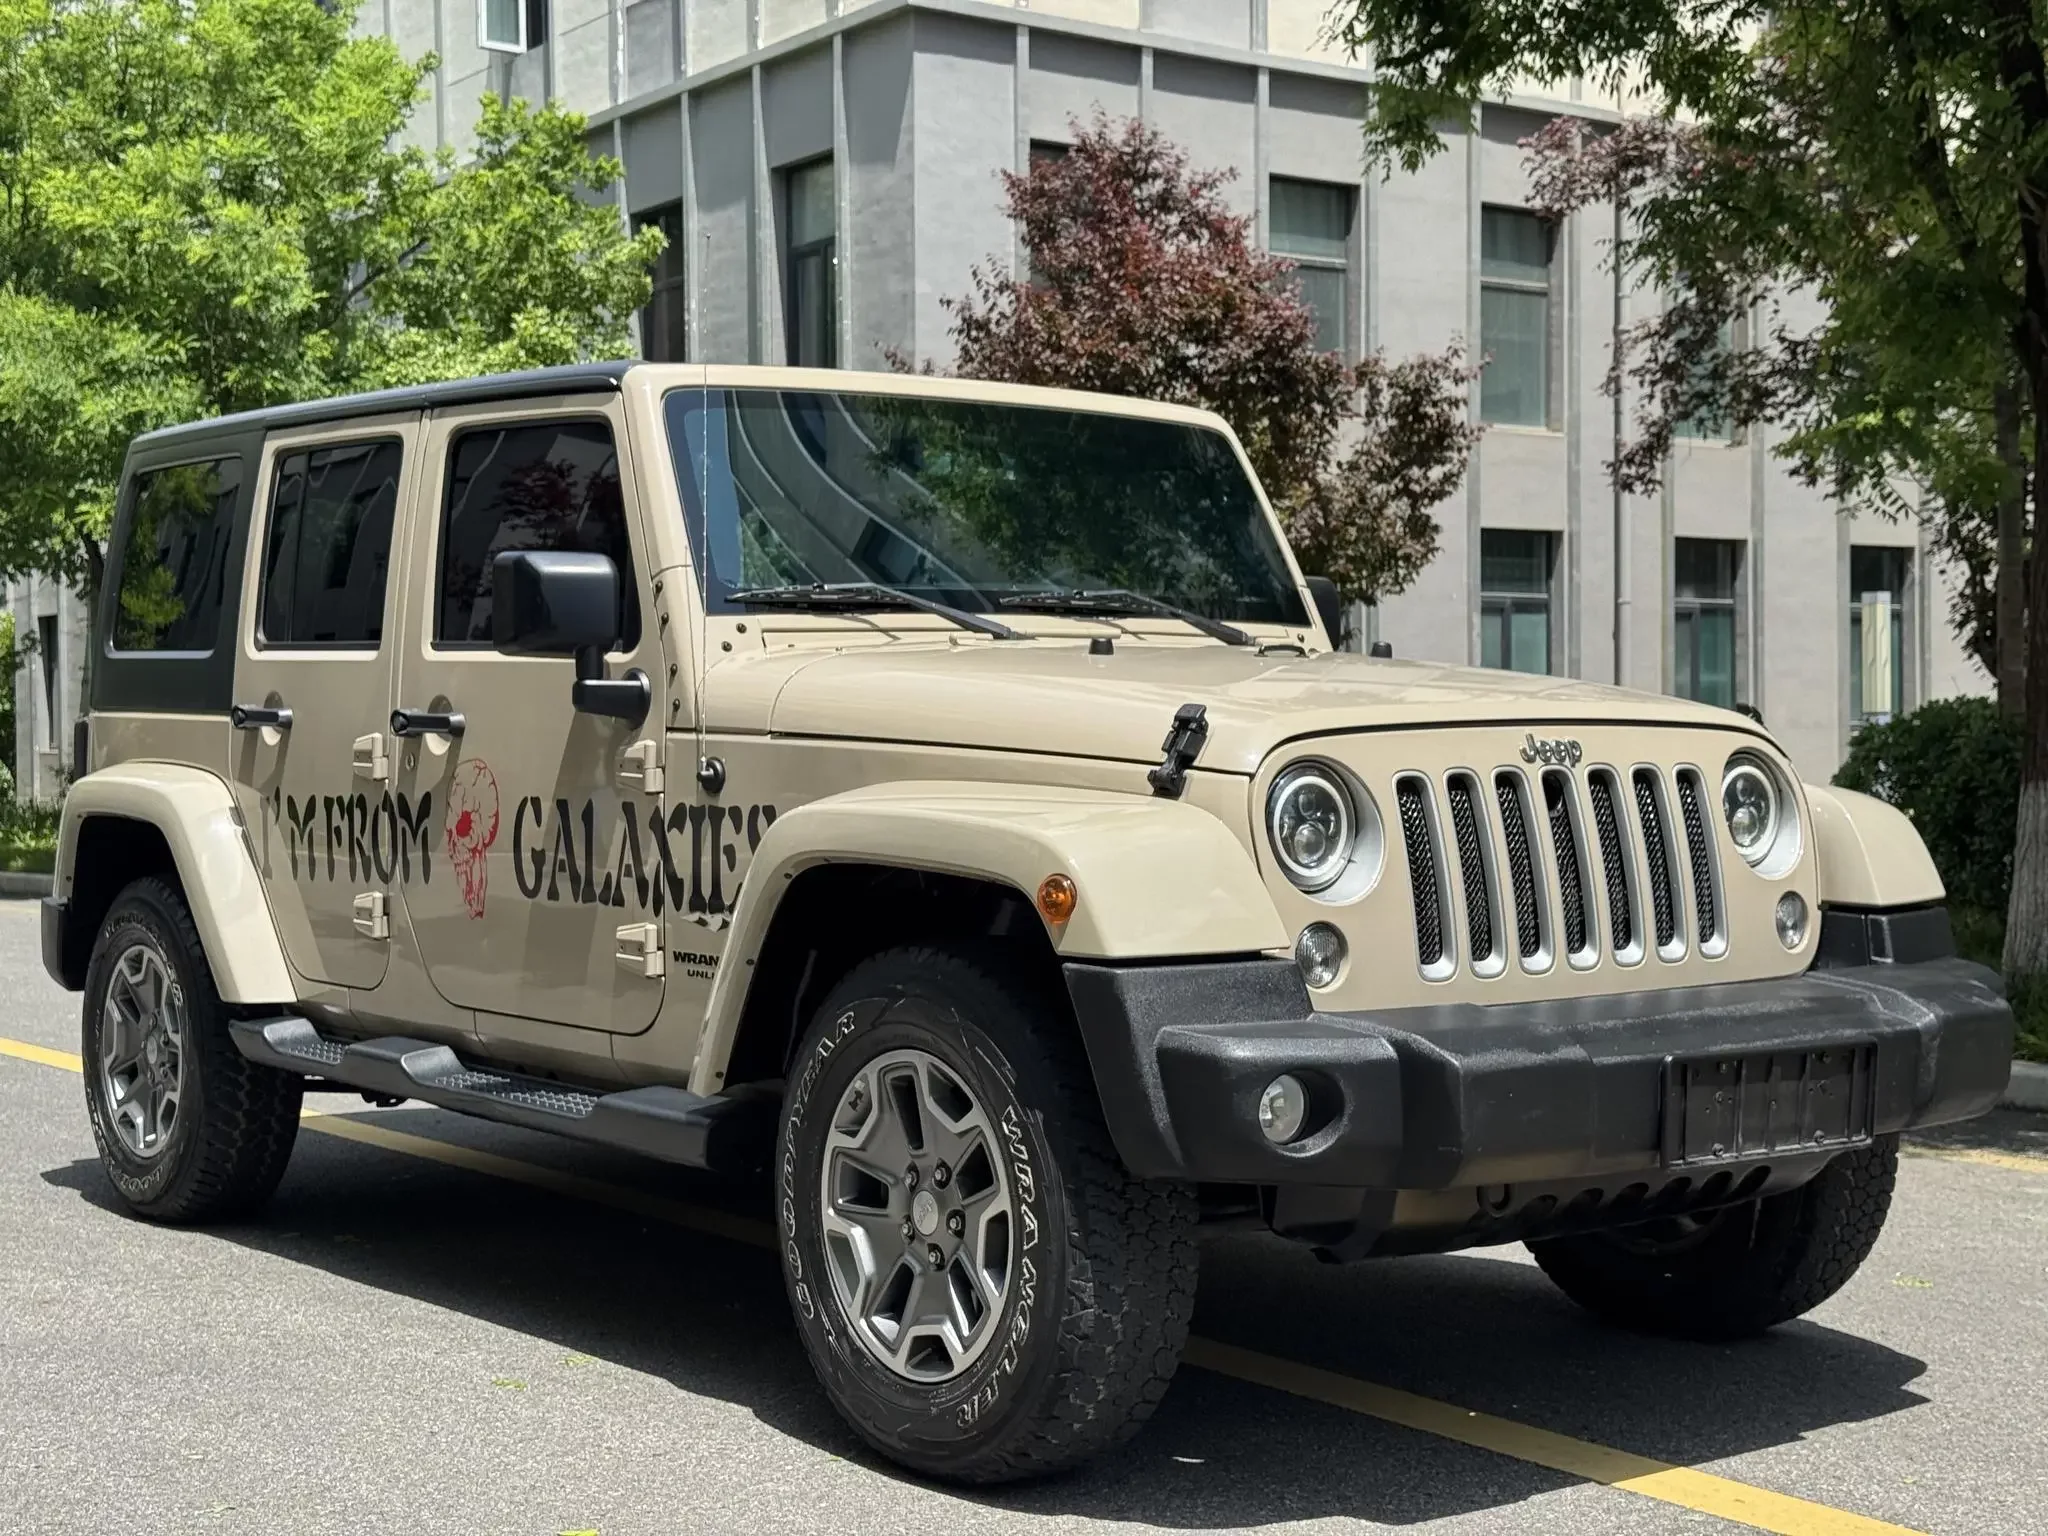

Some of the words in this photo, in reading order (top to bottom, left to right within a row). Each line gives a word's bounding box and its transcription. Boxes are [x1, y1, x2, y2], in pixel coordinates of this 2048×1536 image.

[1520, 733, 1582, 768] Jeep
[783, 1011, 855, 1320] GOODYEAR
[957, 1104, 1039, 1429] WRANGLER
